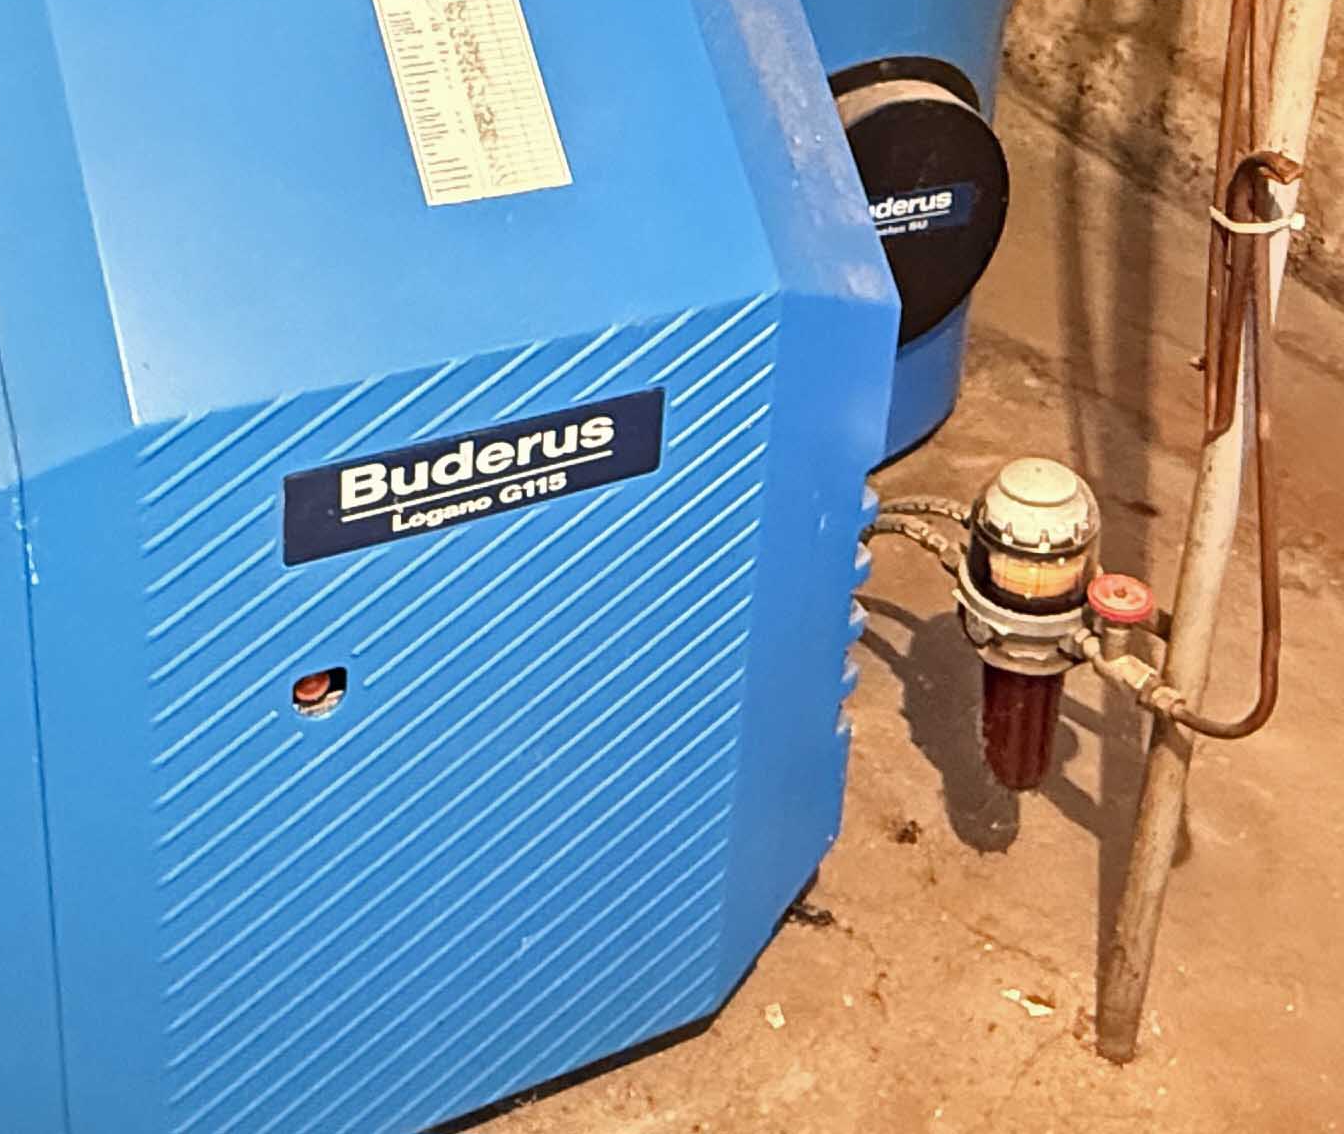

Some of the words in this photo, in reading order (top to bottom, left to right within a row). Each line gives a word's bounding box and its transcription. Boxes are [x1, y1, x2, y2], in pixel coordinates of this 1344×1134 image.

[340, 415, 615, 511] Buderus
[392, 495, 492, 533] Logano
[499, 472, 568, 505] G115
